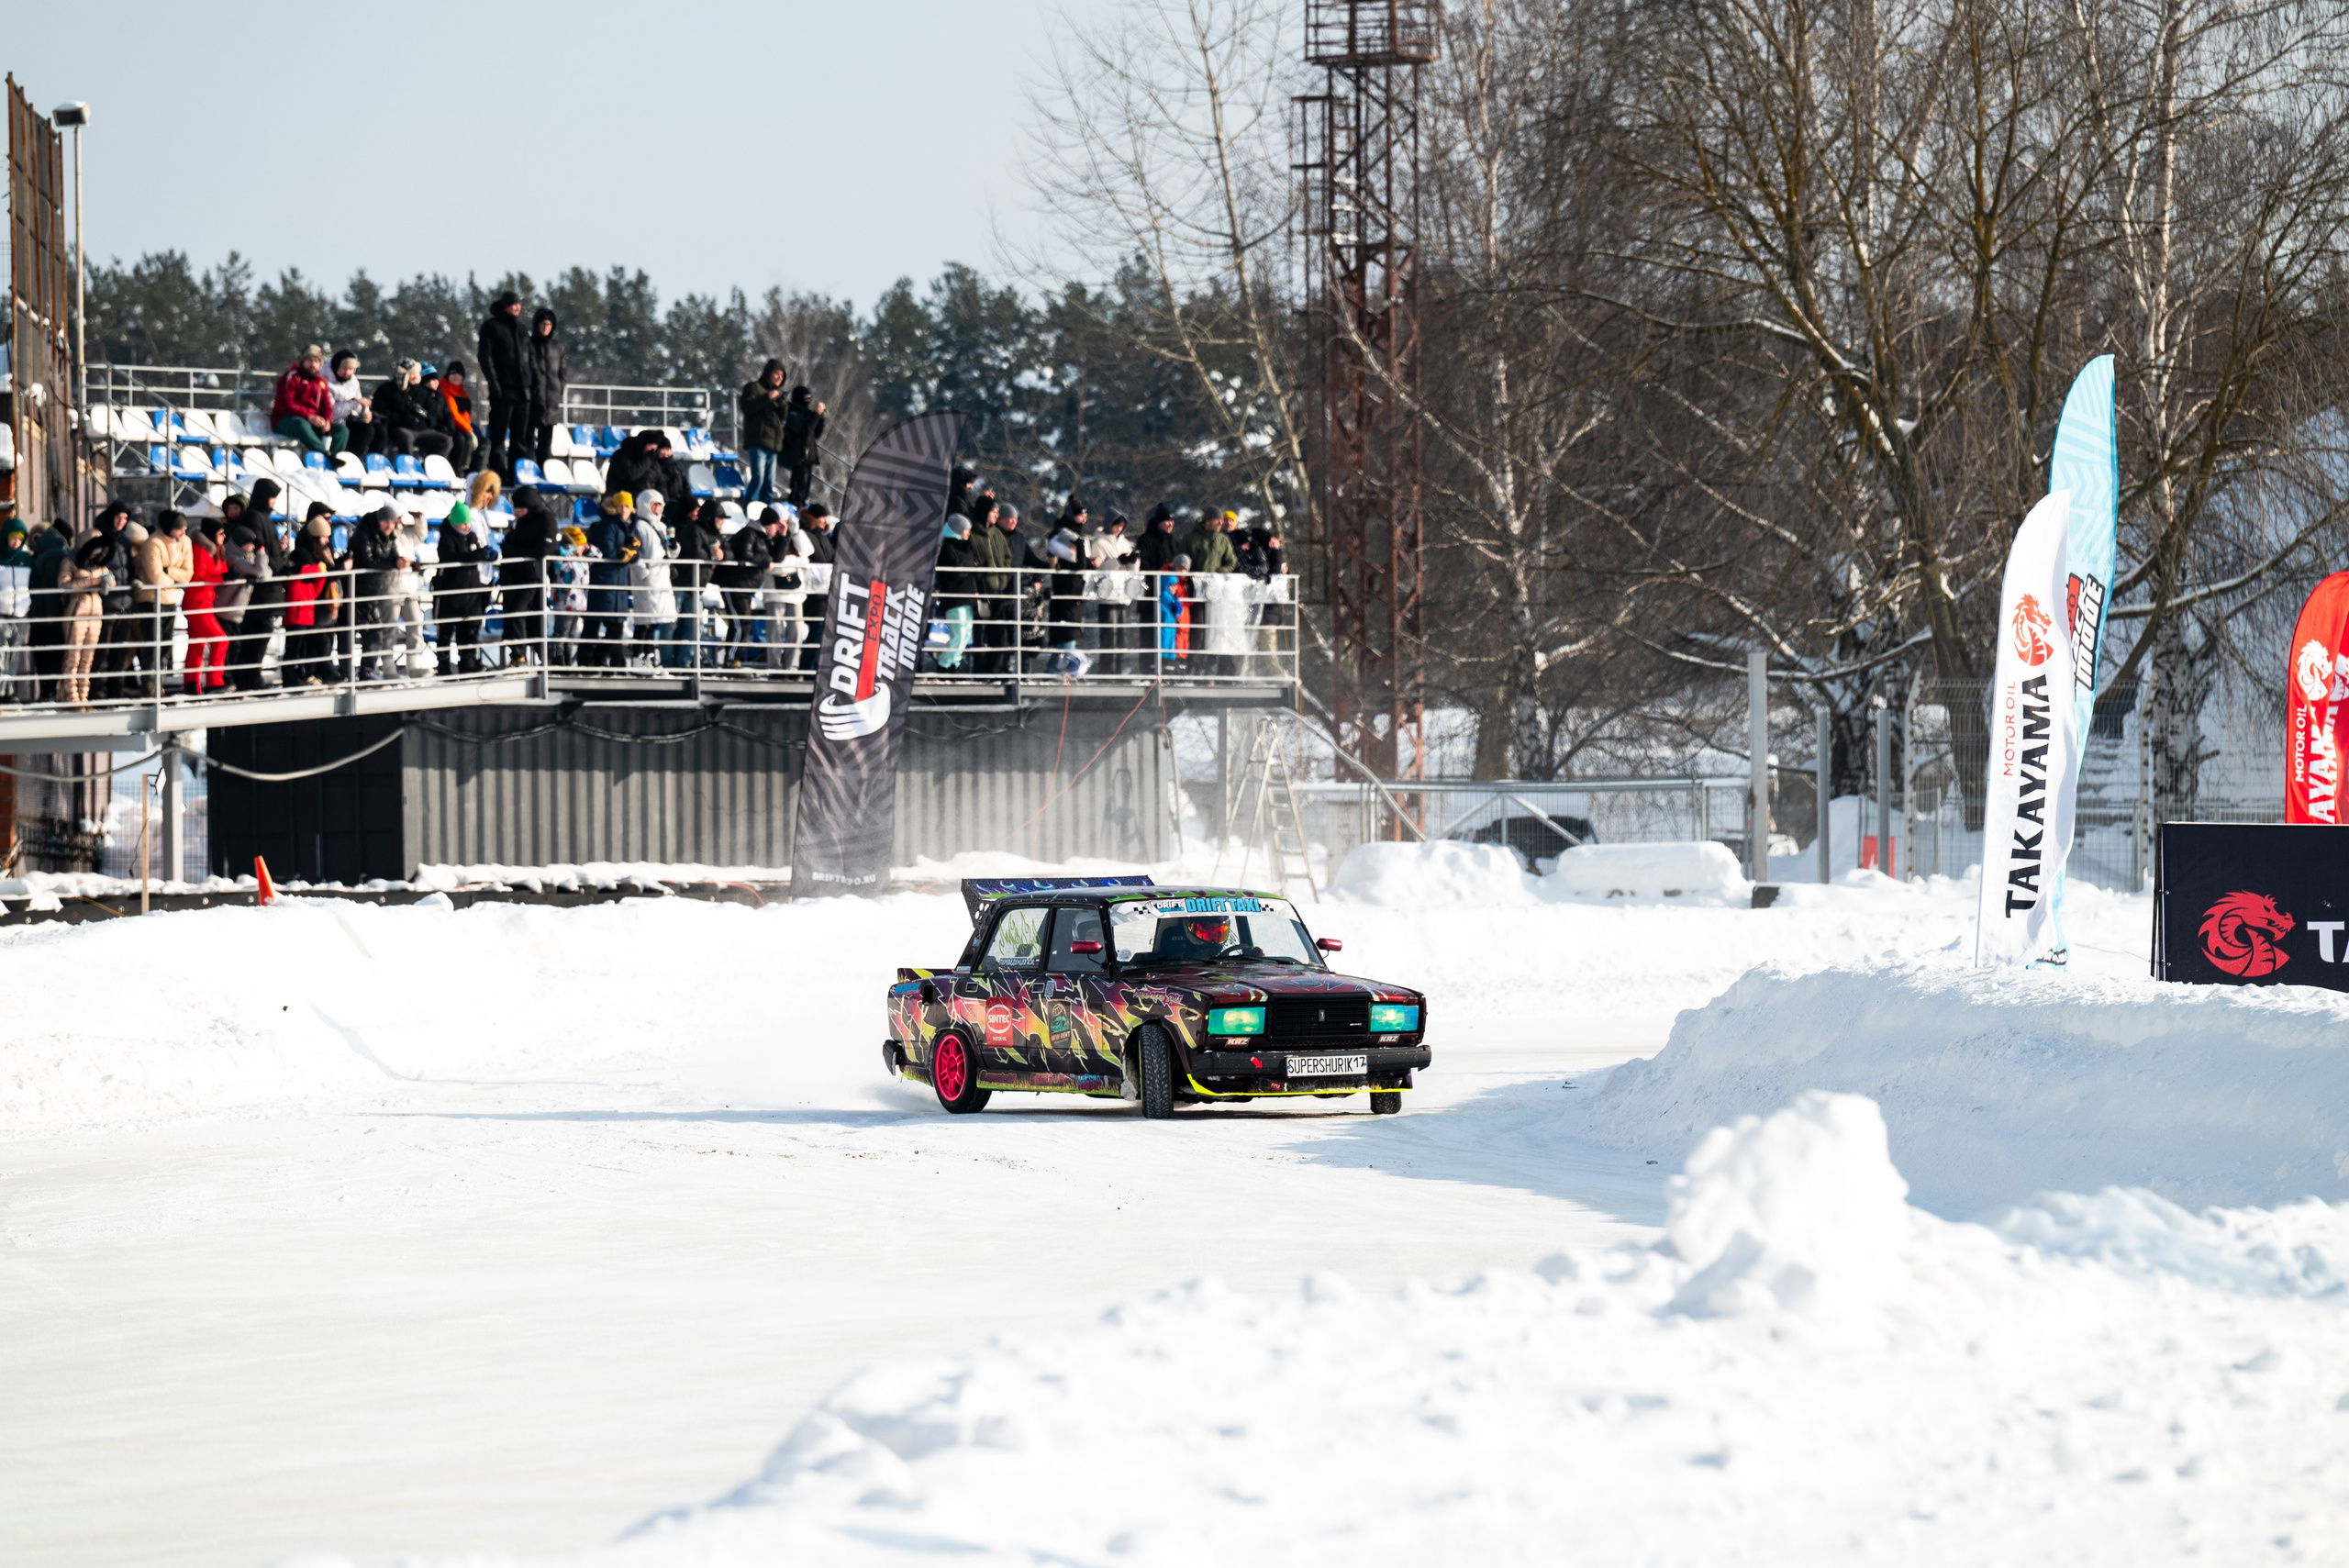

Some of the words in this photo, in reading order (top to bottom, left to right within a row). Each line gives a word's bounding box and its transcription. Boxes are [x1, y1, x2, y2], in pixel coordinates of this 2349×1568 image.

[830, 573, 870, 695] DRIFT
[867, 594, 882, 641] EXPO
[898, 583, 925, 671] MODE
[2076, 574, 2104, 690] MODE
[2006, 681, 2016, 709] OIL
[2296, 705, 2307, 728] OIL
[2003, 715, 2016, 776] MOTOR
[2295, 731, 2306, 782] MOTOR
[2005, 674, 2051, 918] TAKAYAMA
[1157, 902, 1182, 910] DRIFT
[1186, 898, 1228, 913] DRIFT
[1228, 898, 1262, 913] TAXI
[987, 1014, 1010, 1024] SINTEC
[1287, 1057, 1353, 1074] SUPERSHURIK
[1353, 1056, 1366, 1068] 17
